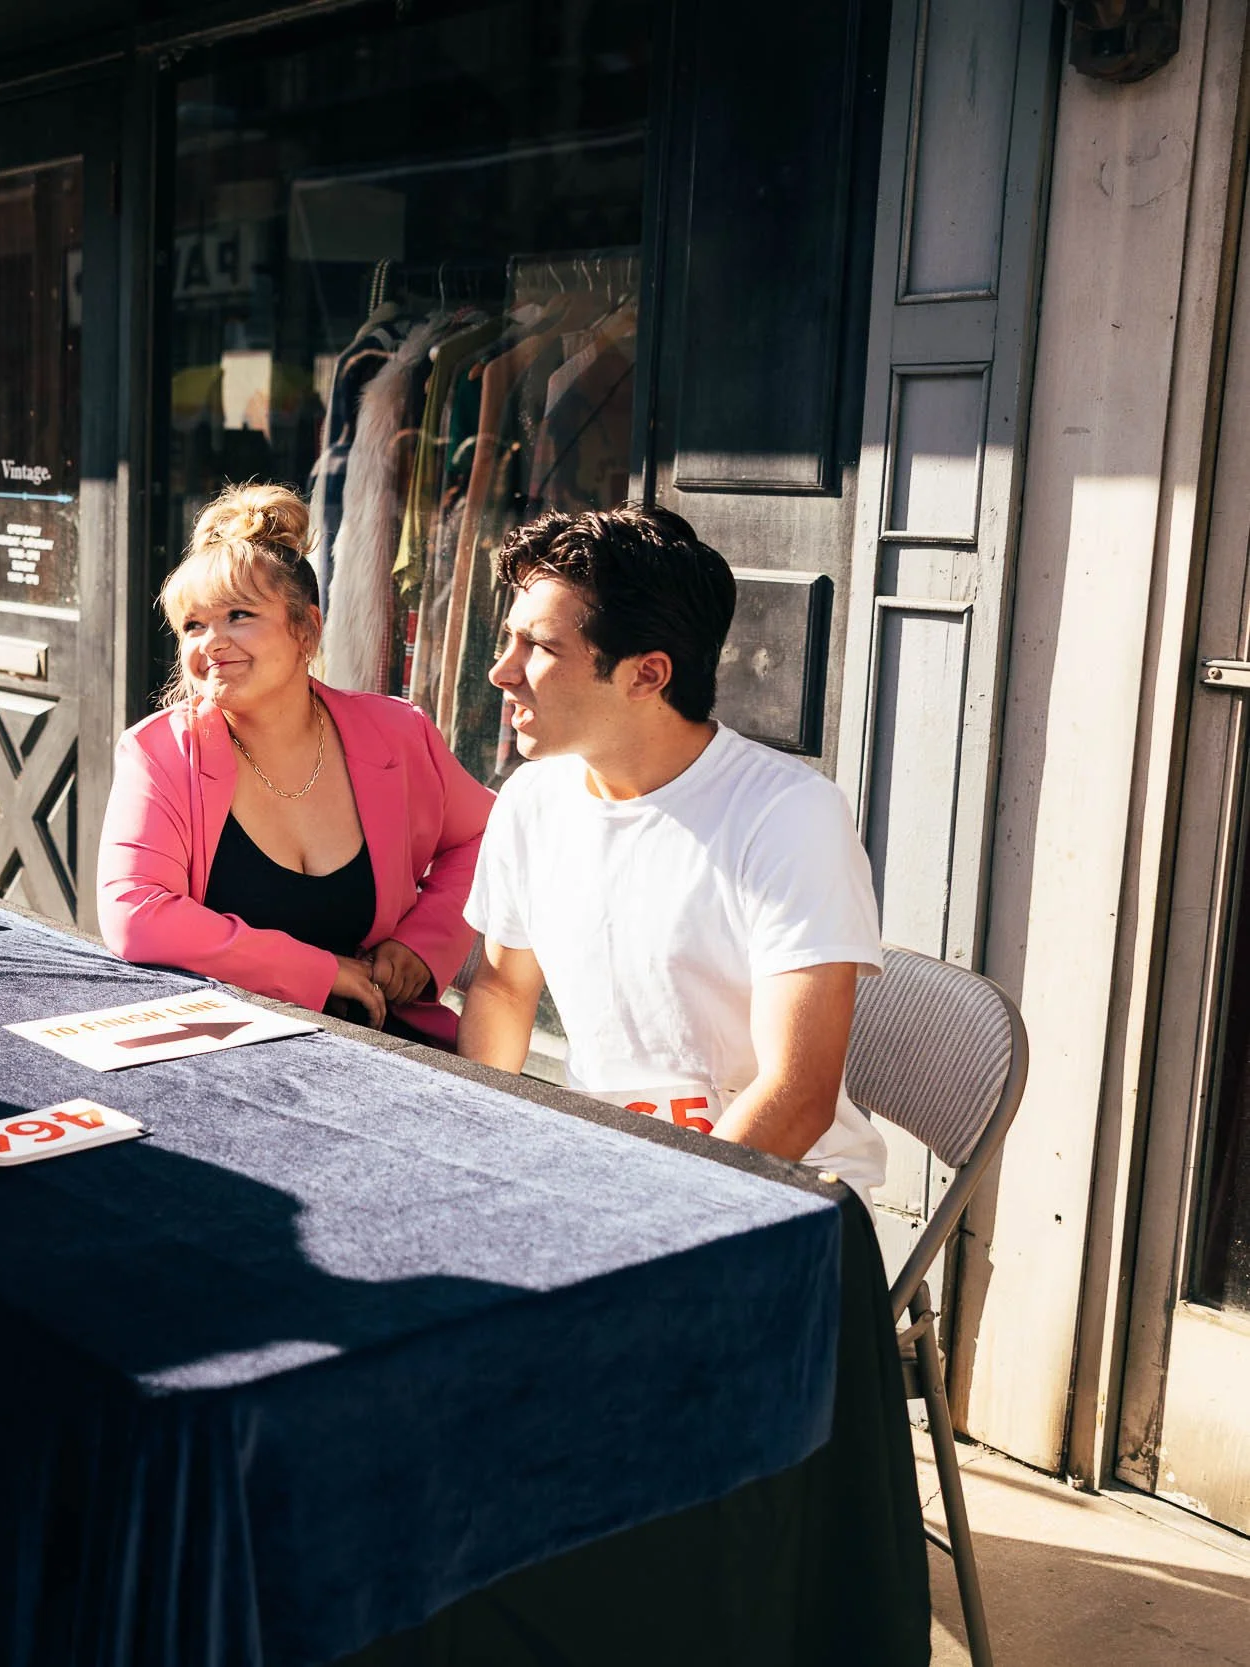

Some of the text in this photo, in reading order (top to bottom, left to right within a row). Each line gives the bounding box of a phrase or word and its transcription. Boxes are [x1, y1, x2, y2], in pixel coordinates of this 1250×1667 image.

[41, 1000, 228, 1039] TO FINISH LINE
[624, 1096, 715, 1135] 5
